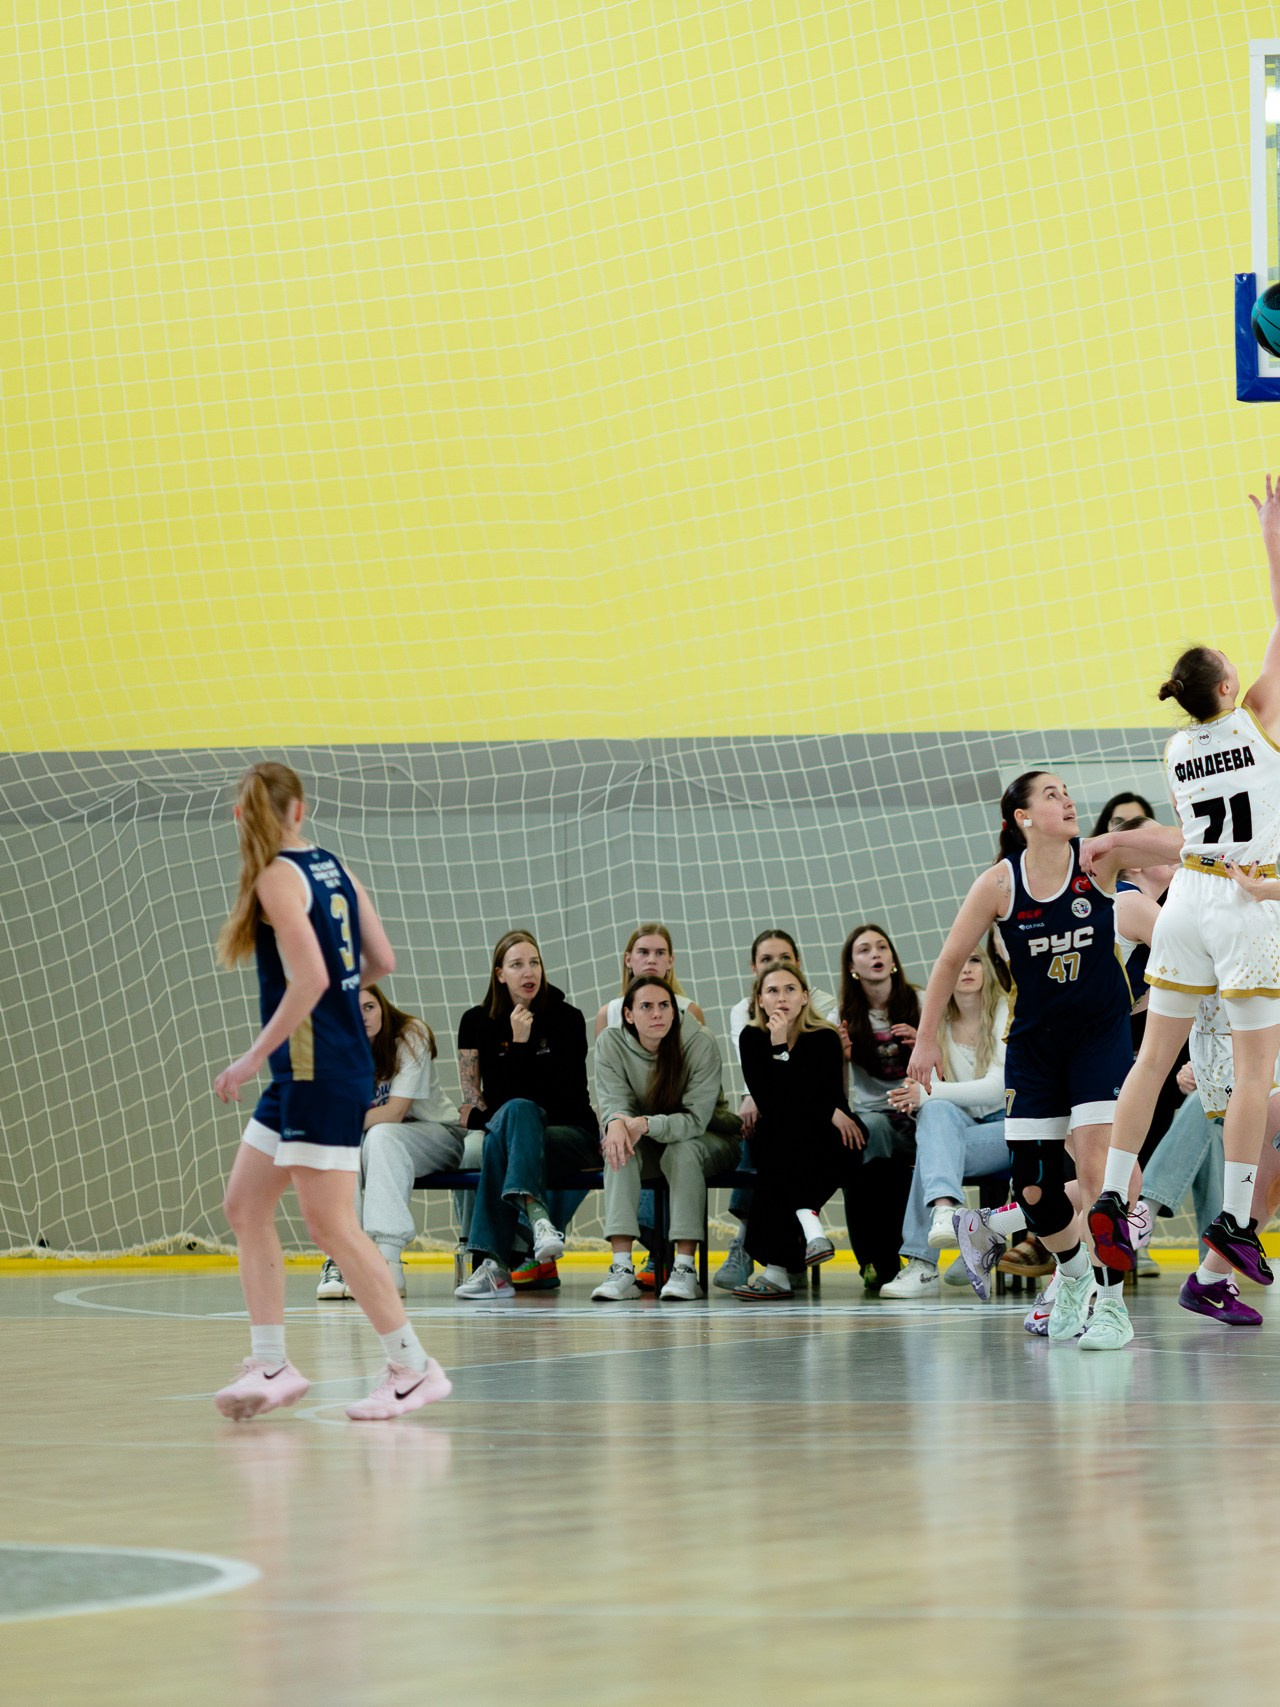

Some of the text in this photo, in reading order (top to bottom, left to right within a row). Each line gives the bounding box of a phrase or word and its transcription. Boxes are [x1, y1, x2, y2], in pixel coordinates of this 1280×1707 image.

[1174, 745, 1256, 783] ФАНДЕЕВА
[1191, 791, 1253, 844] 71
[1028, 926, 1094, 957] РУС
[1047, 952, 1081, 984] 47
